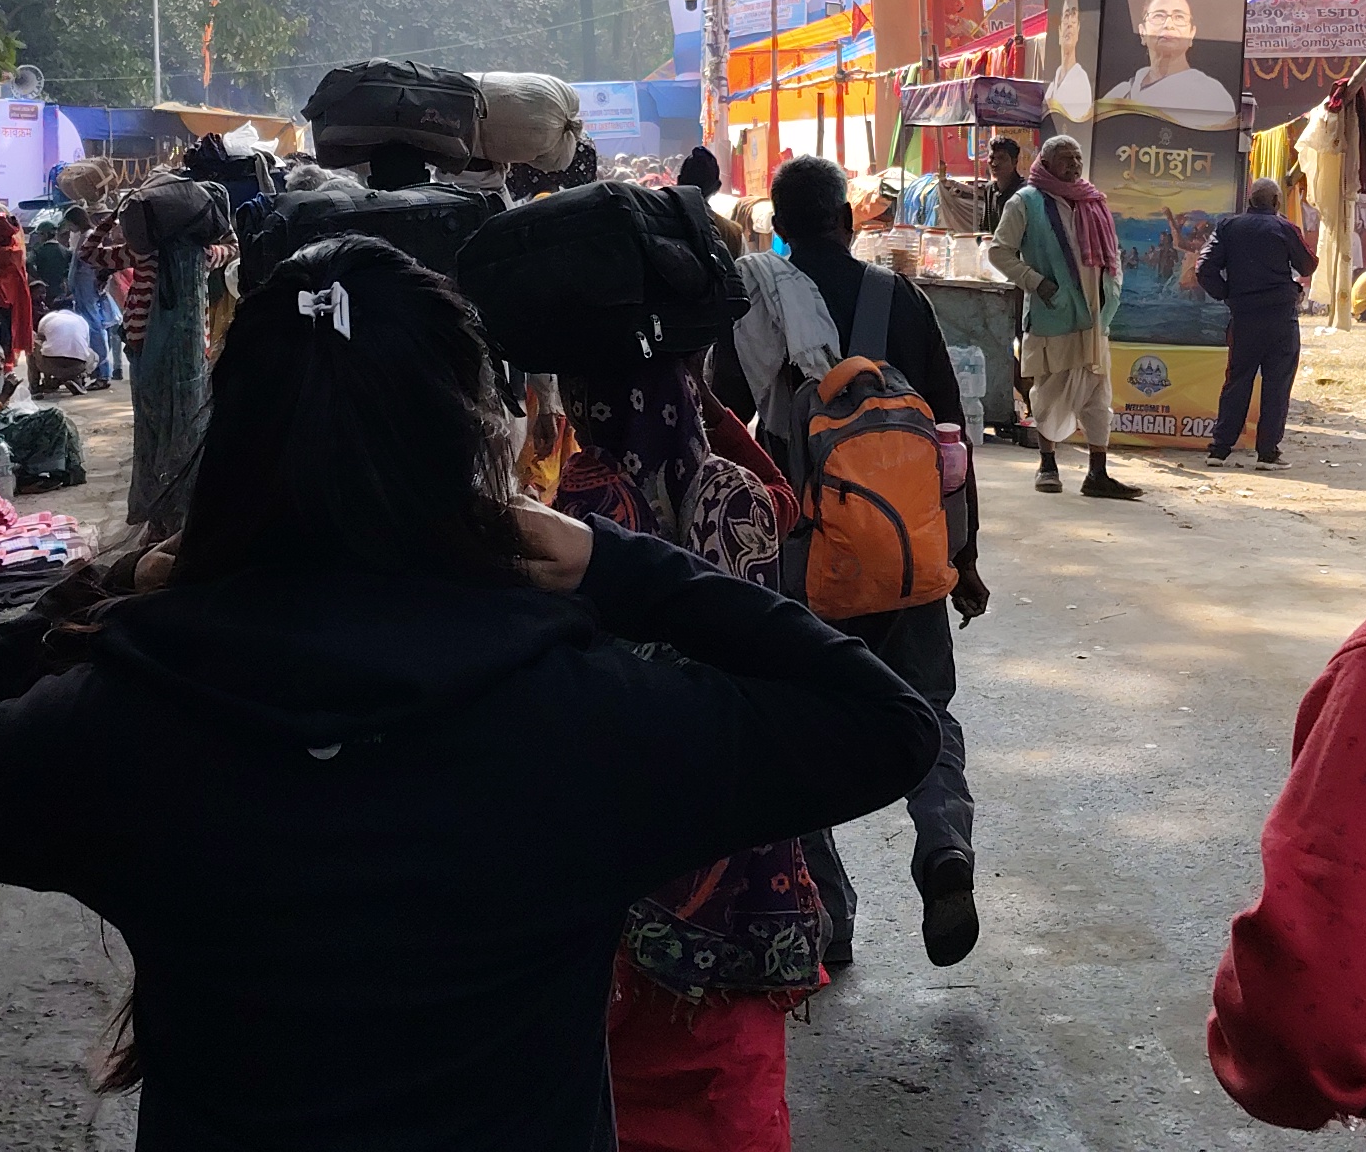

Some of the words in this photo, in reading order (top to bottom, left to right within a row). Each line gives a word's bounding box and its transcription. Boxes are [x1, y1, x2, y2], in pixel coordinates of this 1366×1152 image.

[1246, 37, 1288, 48] E-mail
[1115, 143, 1215, 180] পুণ্যস্থান
[1110, 413, 1177, 437] ASAGAR
[1181, 416, 1218, 438] 202
